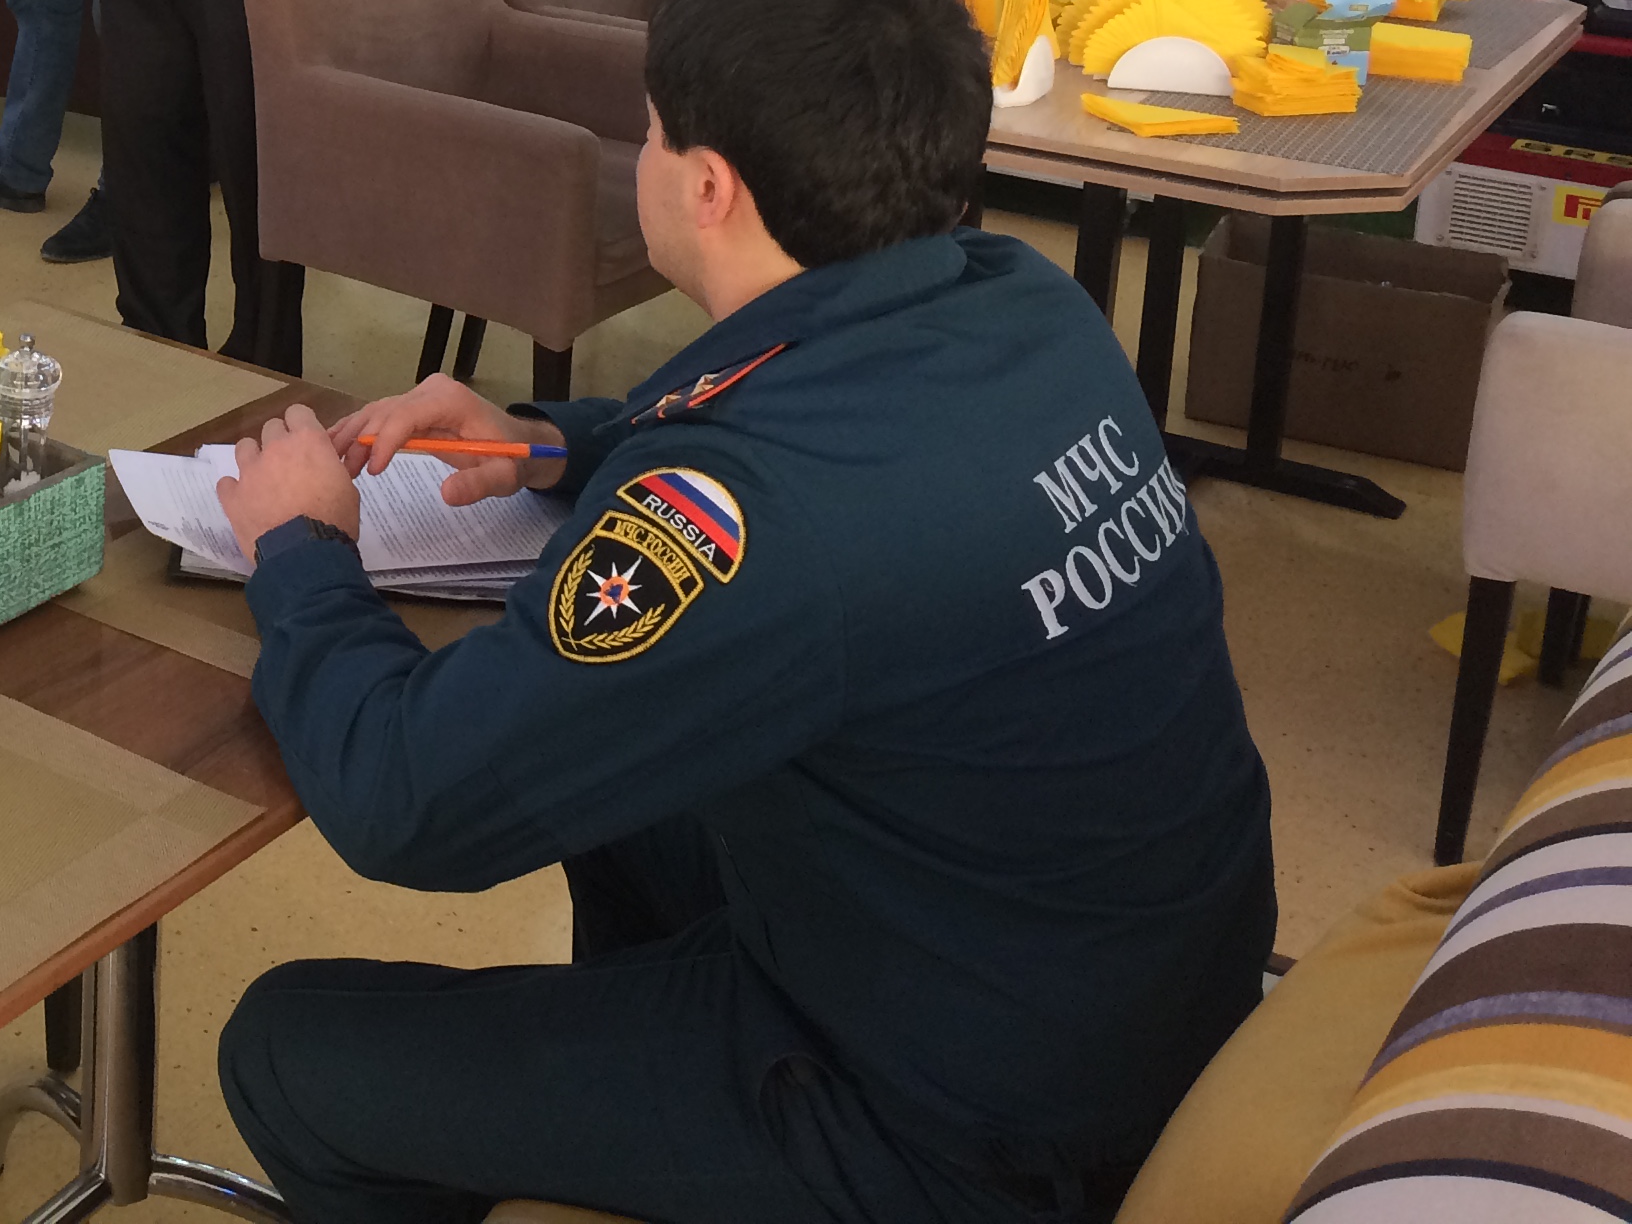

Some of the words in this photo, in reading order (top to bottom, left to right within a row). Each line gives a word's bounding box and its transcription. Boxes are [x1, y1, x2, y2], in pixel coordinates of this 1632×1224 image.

[1032, 414, 1140, 534] МЧС
[613, 520, 647, 544] МЧС
[643, 531, 692, 585] РОССИИ
[641, 493, 718, 562] RUSSIA
[1020, 455, 1189, 641] РОССИИ
